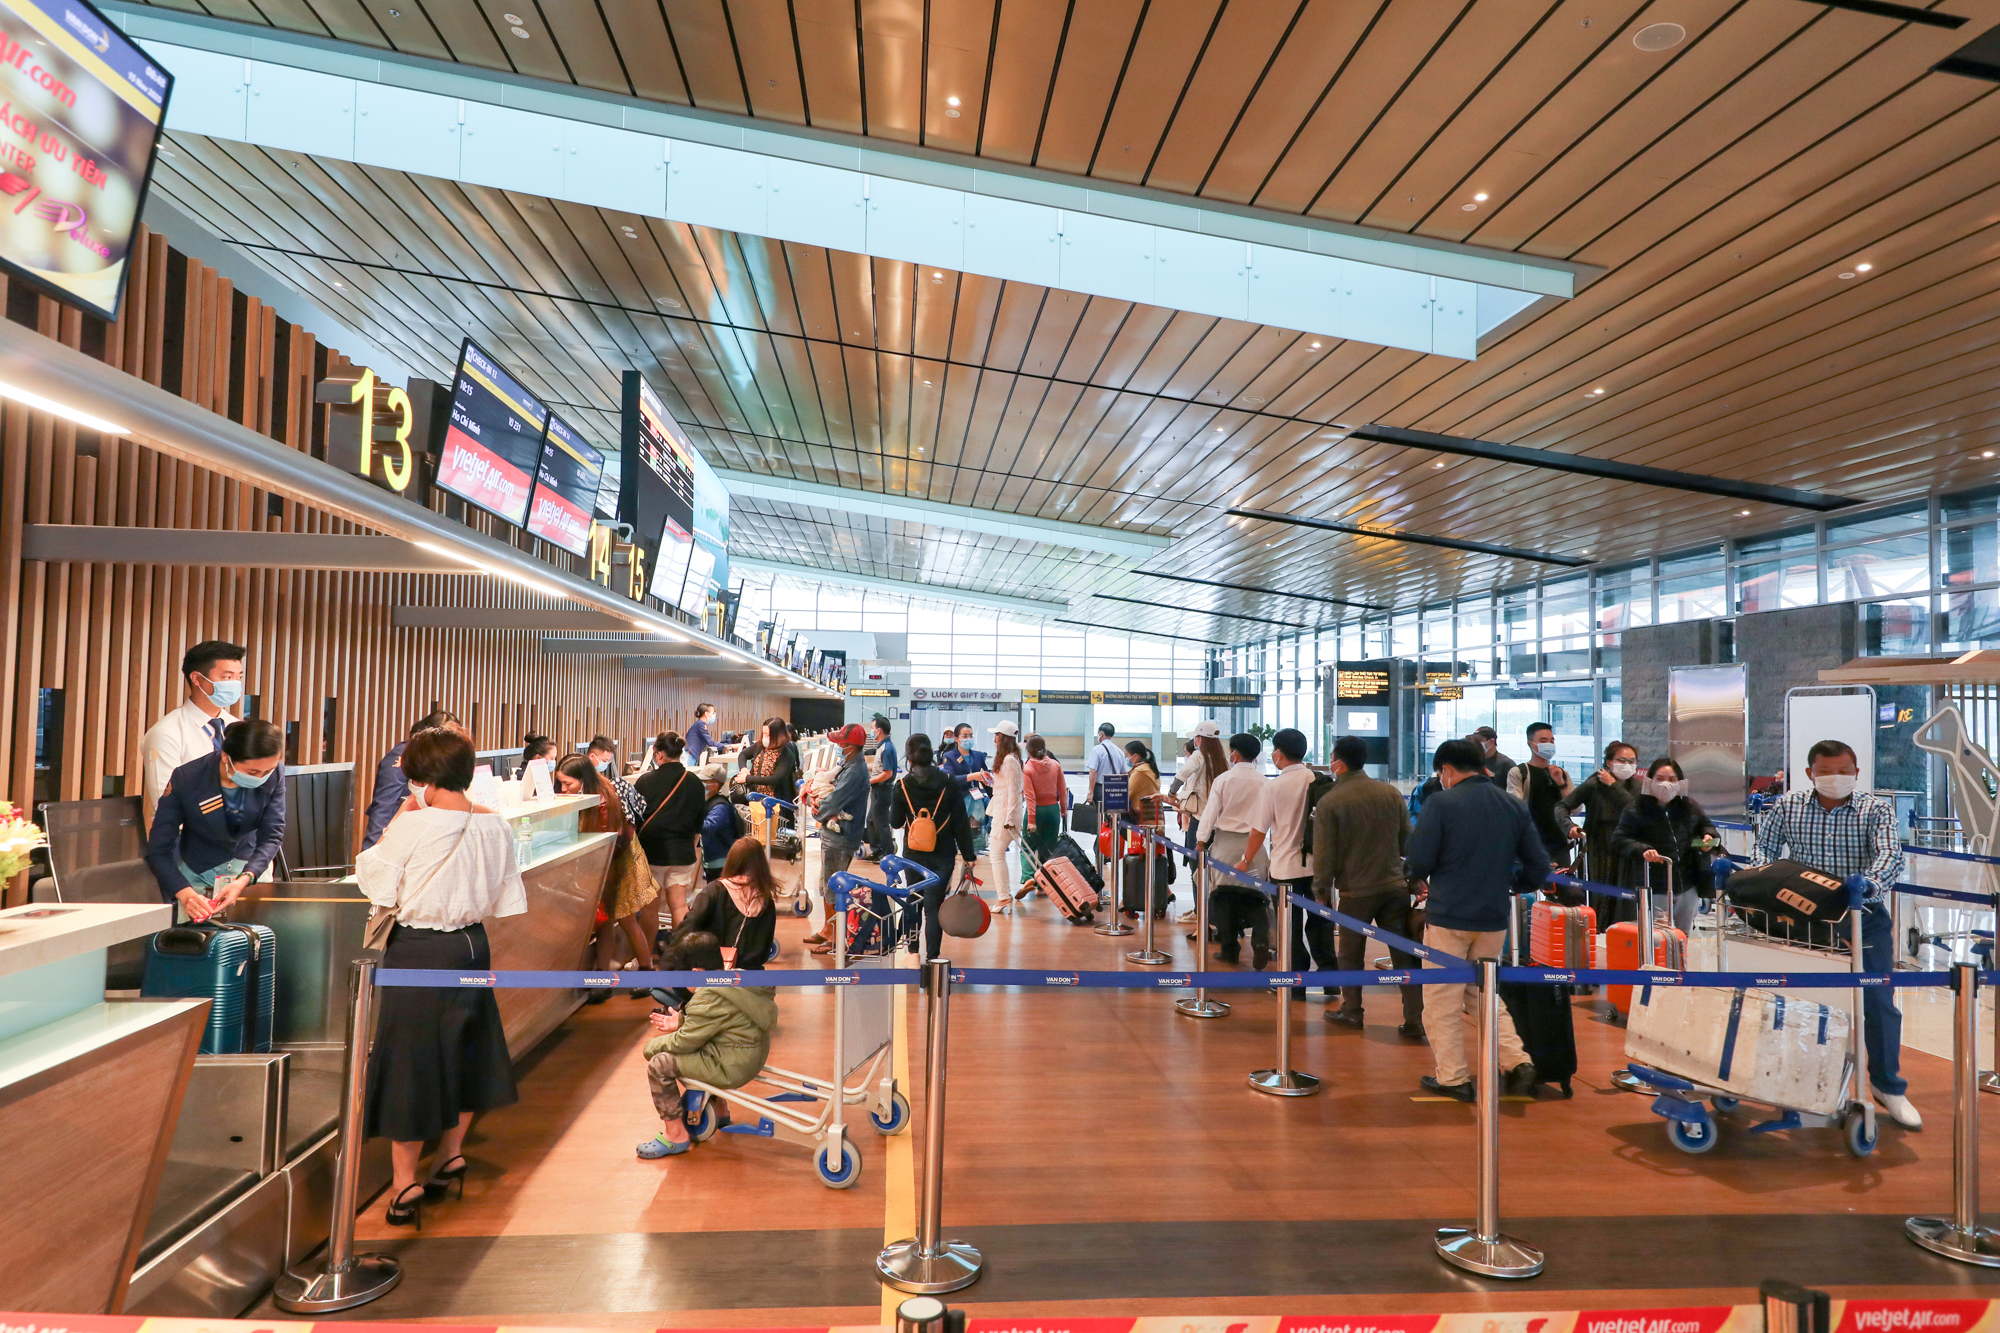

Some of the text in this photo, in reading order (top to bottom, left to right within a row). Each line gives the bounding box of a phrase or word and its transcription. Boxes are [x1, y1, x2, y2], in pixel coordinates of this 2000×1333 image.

[72, 151, 107, 190] TIÊN
[472, 353, 492, 376] CHECK-IN
[492, 369, 498, 379] 13
[460, 380, 474, 396] 10:15
[351, 367, 413, 492] 13
[452, 409, 481, 436] Ho Chi Minh
[589, 518, 611, 590] 14
[628, 543, 645, 602] 15
[960, 691, 978, 699] GIFT
